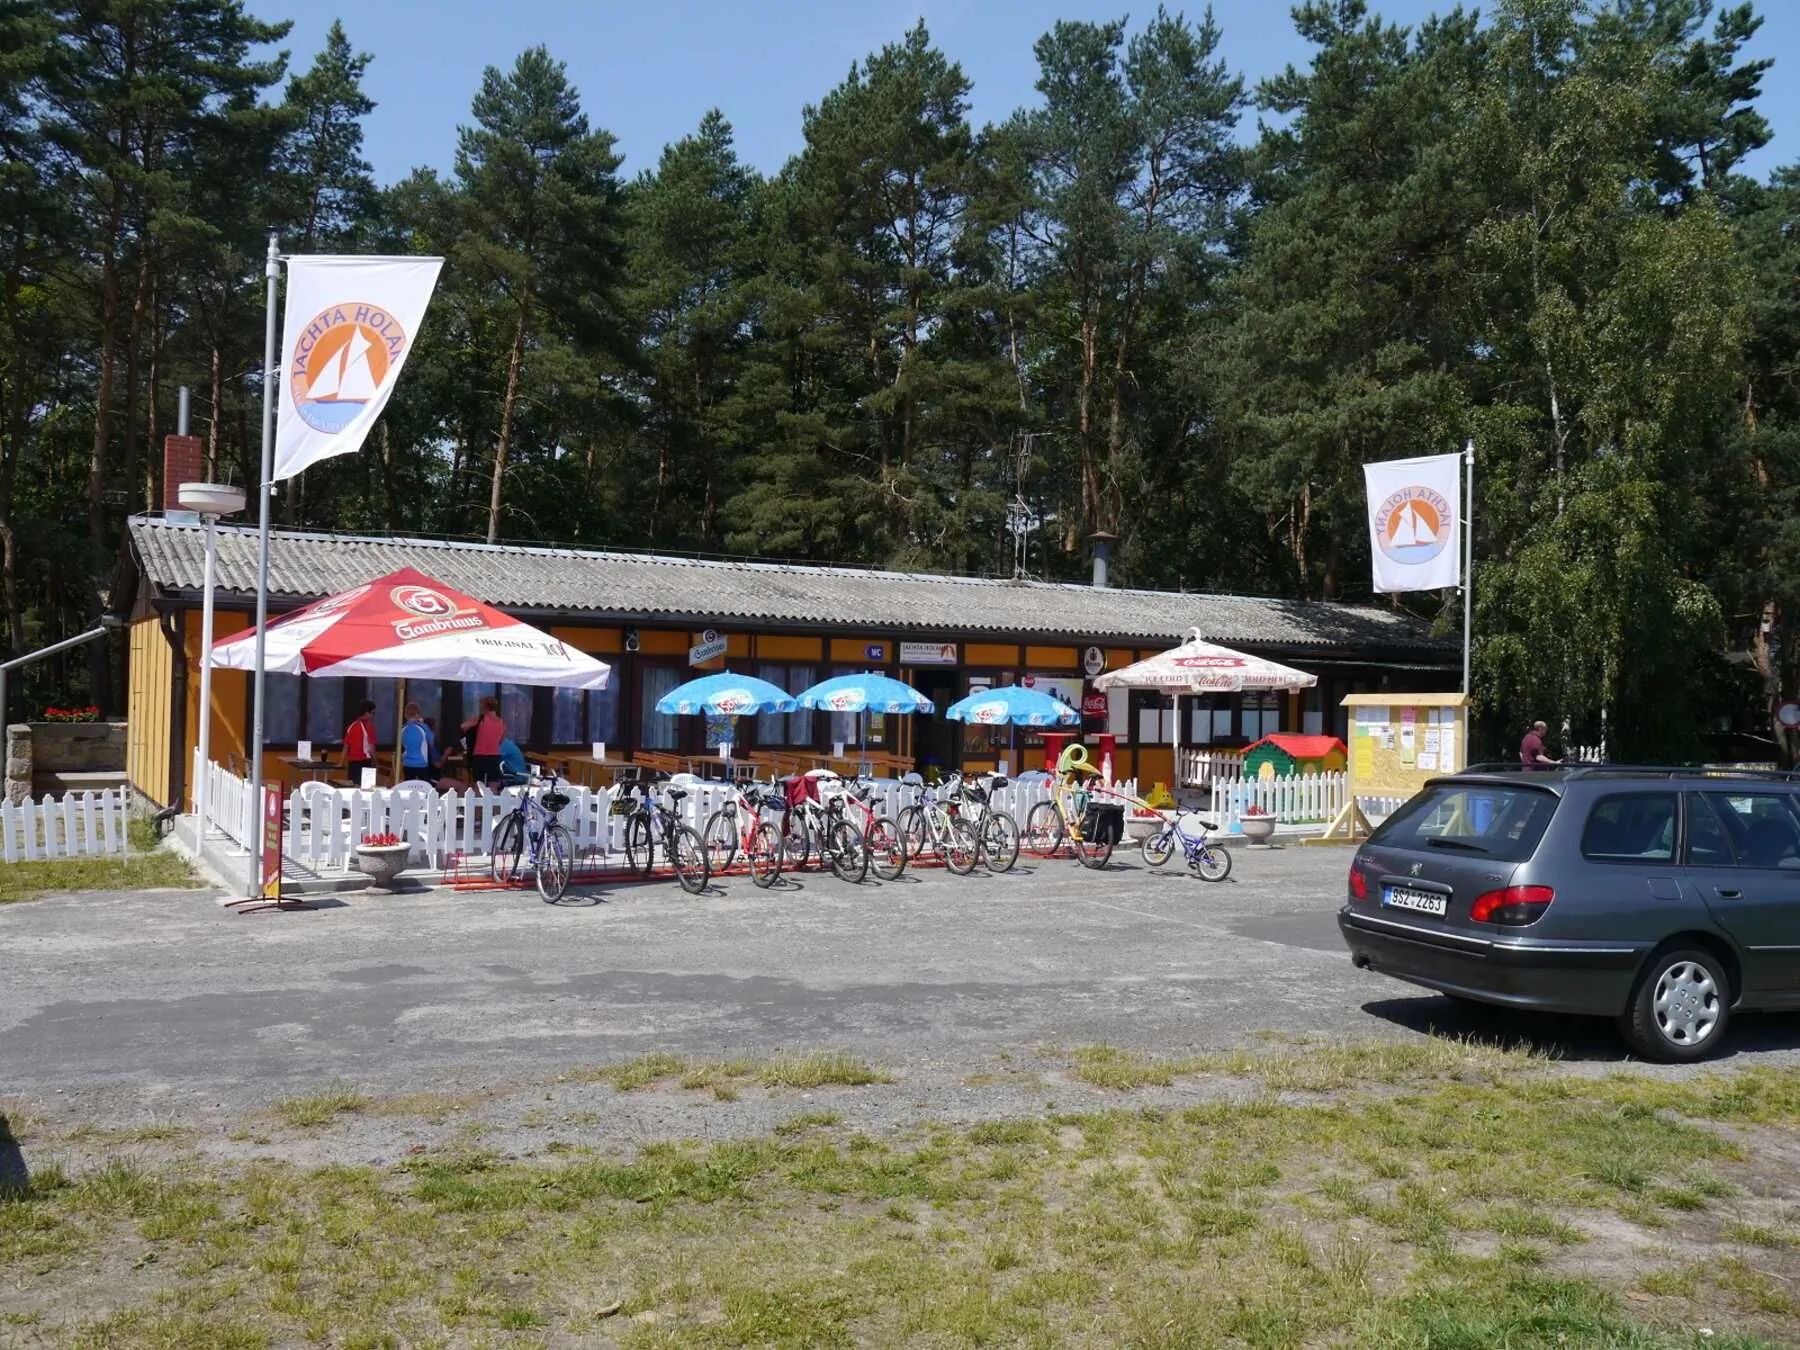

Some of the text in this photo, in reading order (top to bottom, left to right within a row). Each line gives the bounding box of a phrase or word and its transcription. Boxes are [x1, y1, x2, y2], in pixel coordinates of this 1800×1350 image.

[294, 307, 402, 375] JACHTA HOLAN
[395, 612, 483, 641] Gambrinus
[475, 637, 538, 650] ORIGINAL
[871, 648, 882, 657] WC
[1392, 889, 1442, 911] 9S2 2263
